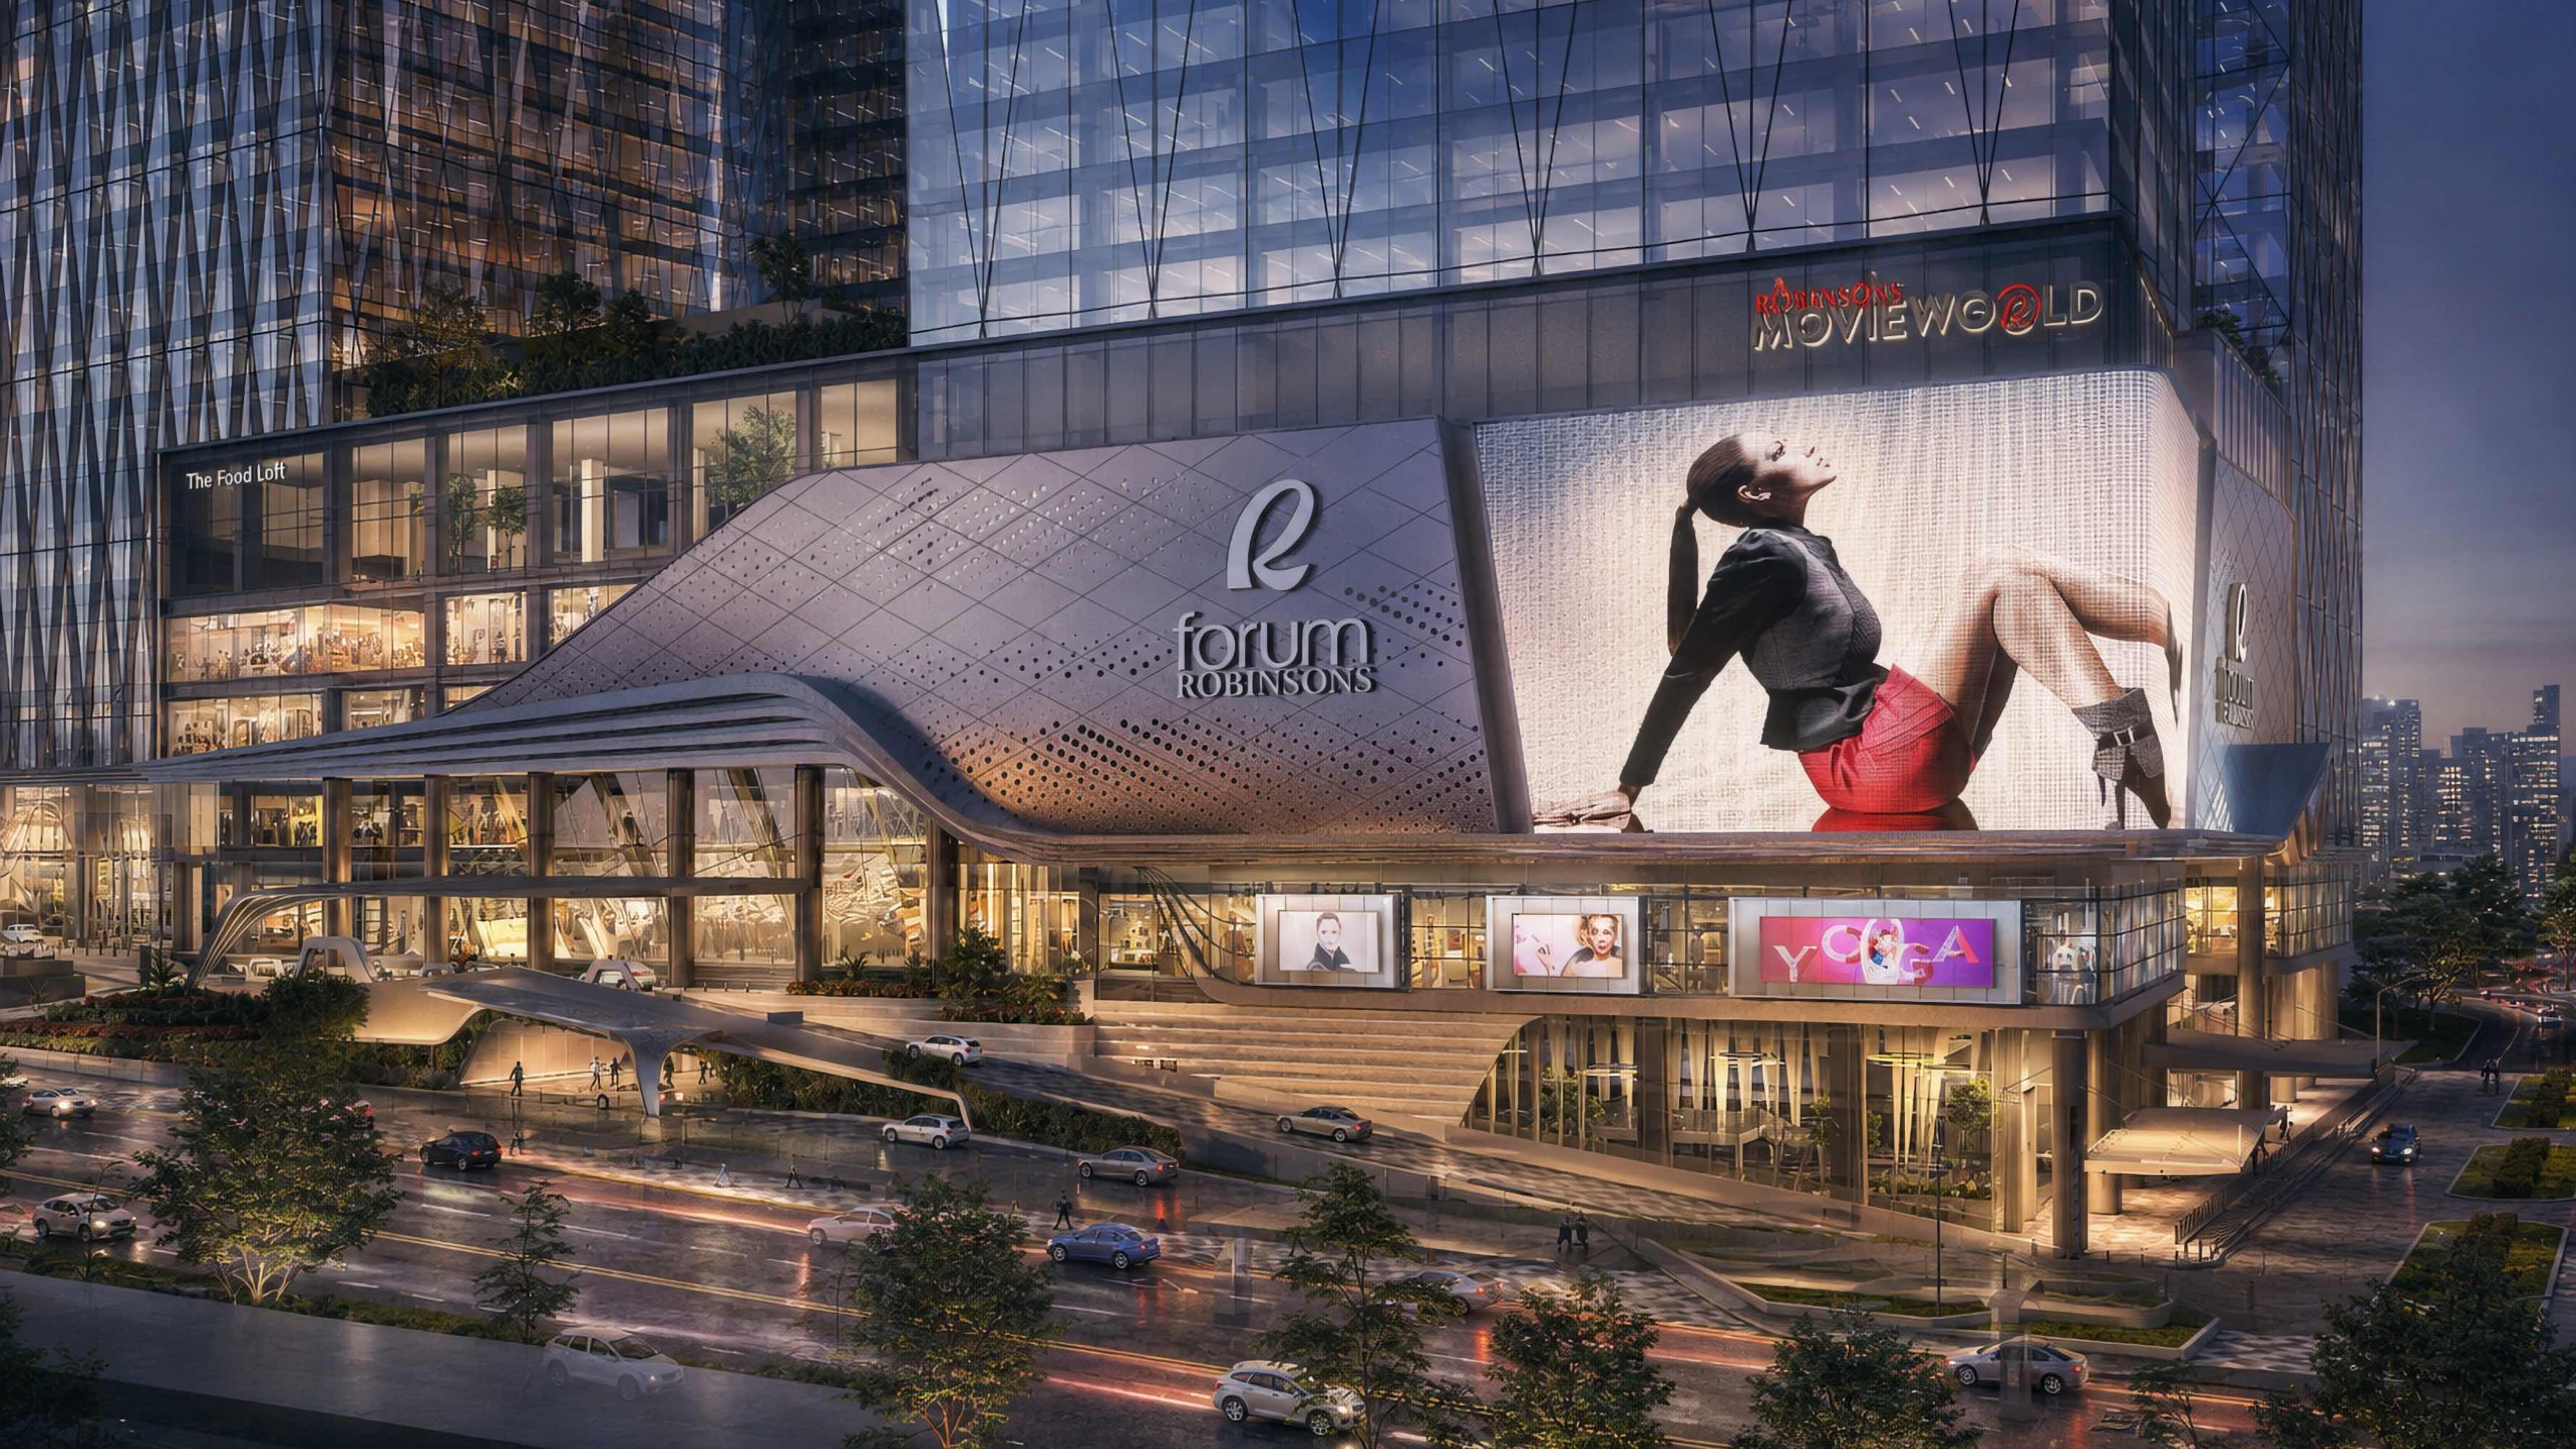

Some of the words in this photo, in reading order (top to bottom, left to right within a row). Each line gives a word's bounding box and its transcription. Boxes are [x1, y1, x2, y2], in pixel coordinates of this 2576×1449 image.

[186, 472, 212, 490] The
[217, 465, 251, 487] Food
[256, 461, 286, 482] Loft
[1172, 610, 1371, 671] forum
[1177, 667, 1374, 698] ROBINSONS
